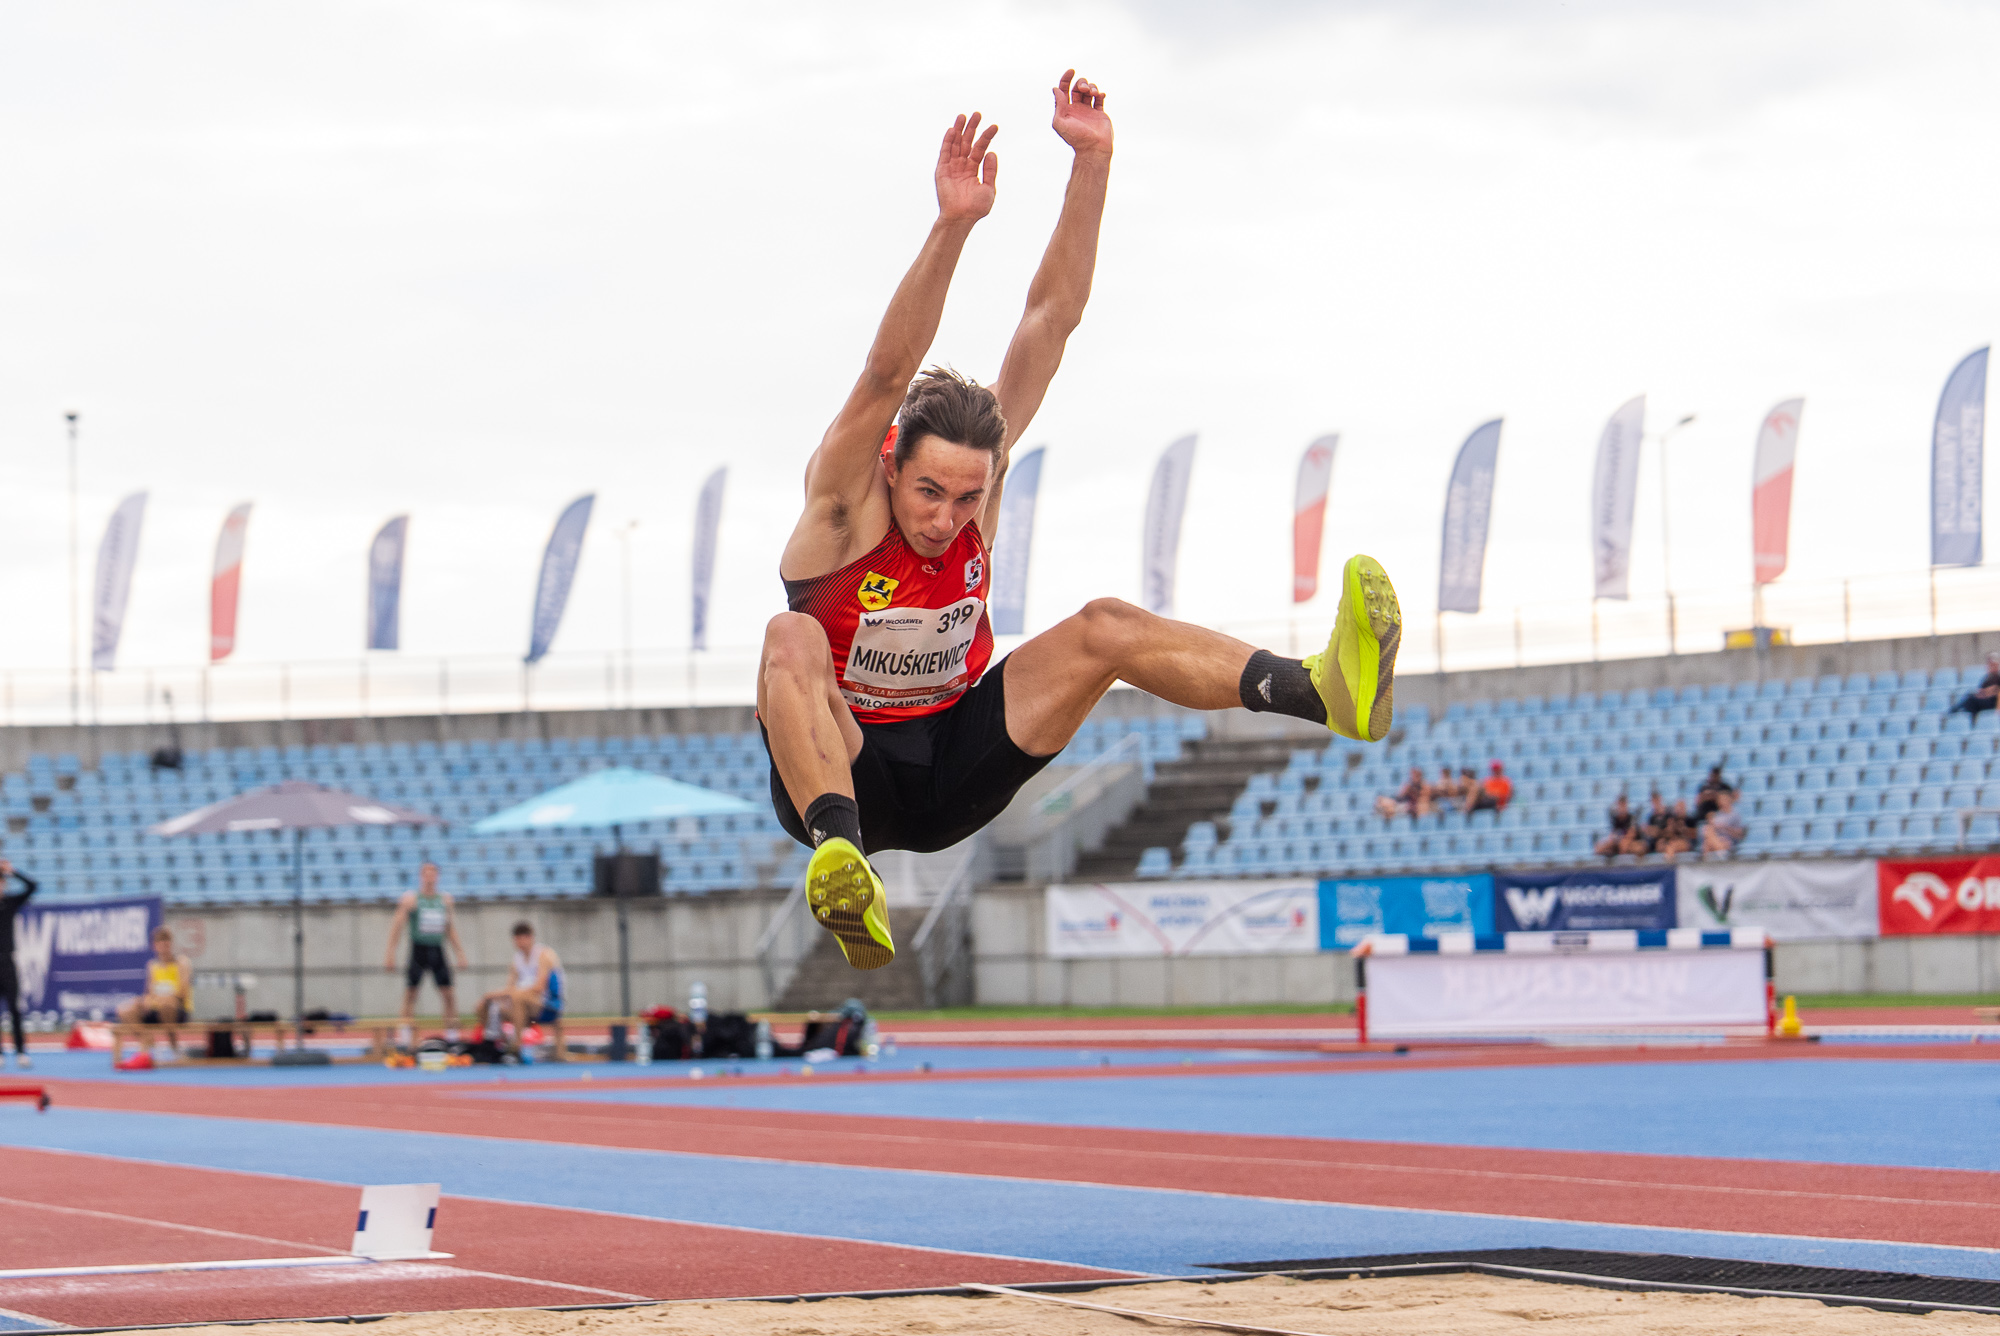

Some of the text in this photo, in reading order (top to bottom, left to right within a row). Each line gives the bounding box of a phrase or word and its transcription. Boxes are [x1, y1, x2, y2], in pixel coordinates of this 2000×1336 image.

[937, 604, 974, 634] 399
[852, 638, 972, 676] MIKUŚKIEWICZ
[854, 696, 930, 709] WŁOCŁAWEK
